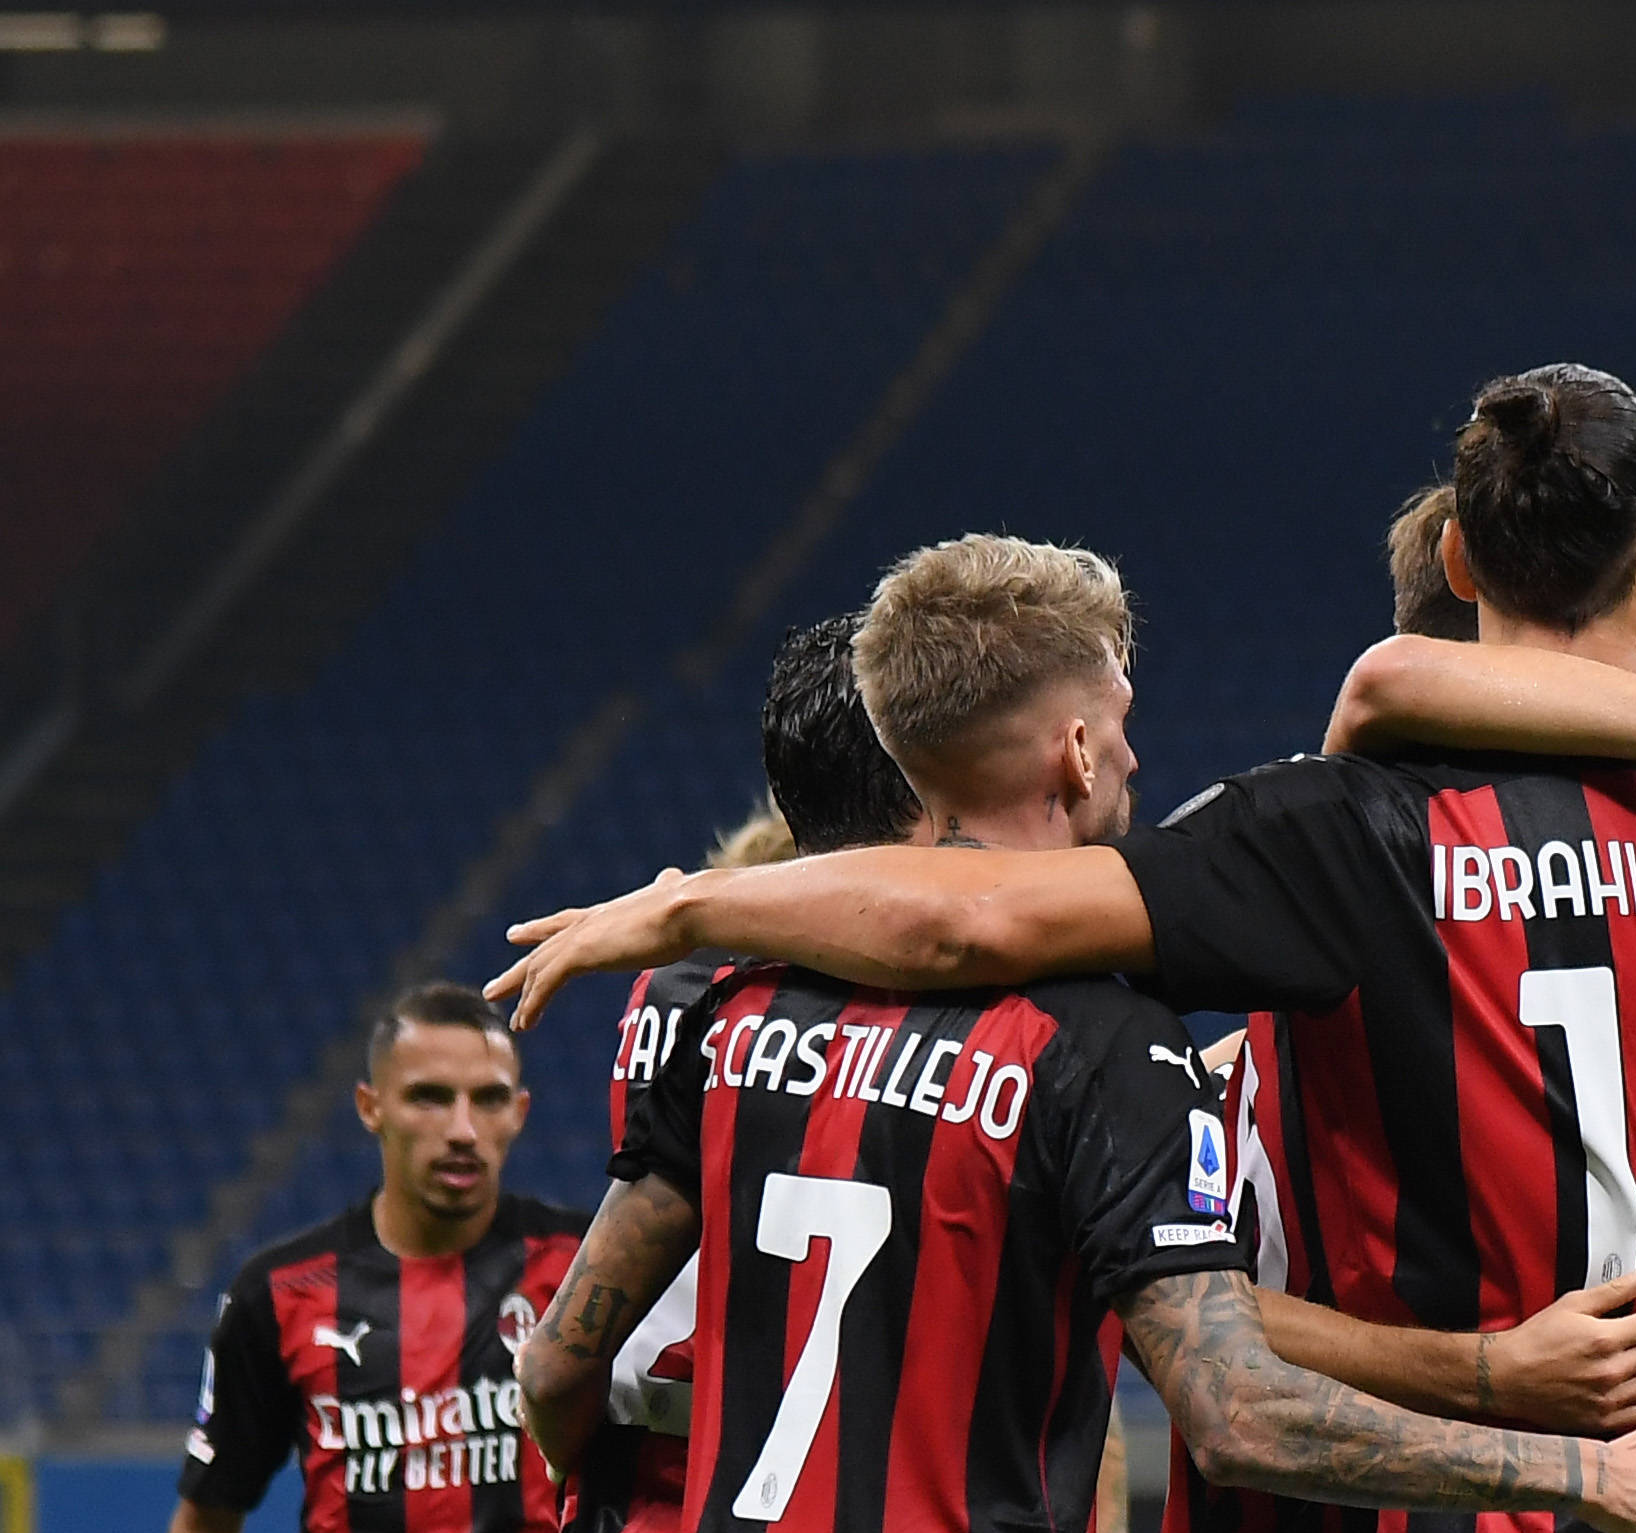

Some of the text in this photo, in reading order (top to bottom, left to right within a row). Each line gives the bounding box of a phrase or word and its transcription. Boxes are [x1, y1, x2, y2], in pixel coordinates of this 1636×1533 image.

[701, 1013, 1029, 1140] S.CASTILLEJO
[1194, 1177, 1214, 1192] SERIE
[1158, 1229, 1188, 1242] KEEP
[732, 1172, 892, 1522] 7
[312, 1377, 521, 1449] Emirate
[345, 1434, 518, 1493] FLY BETTER
